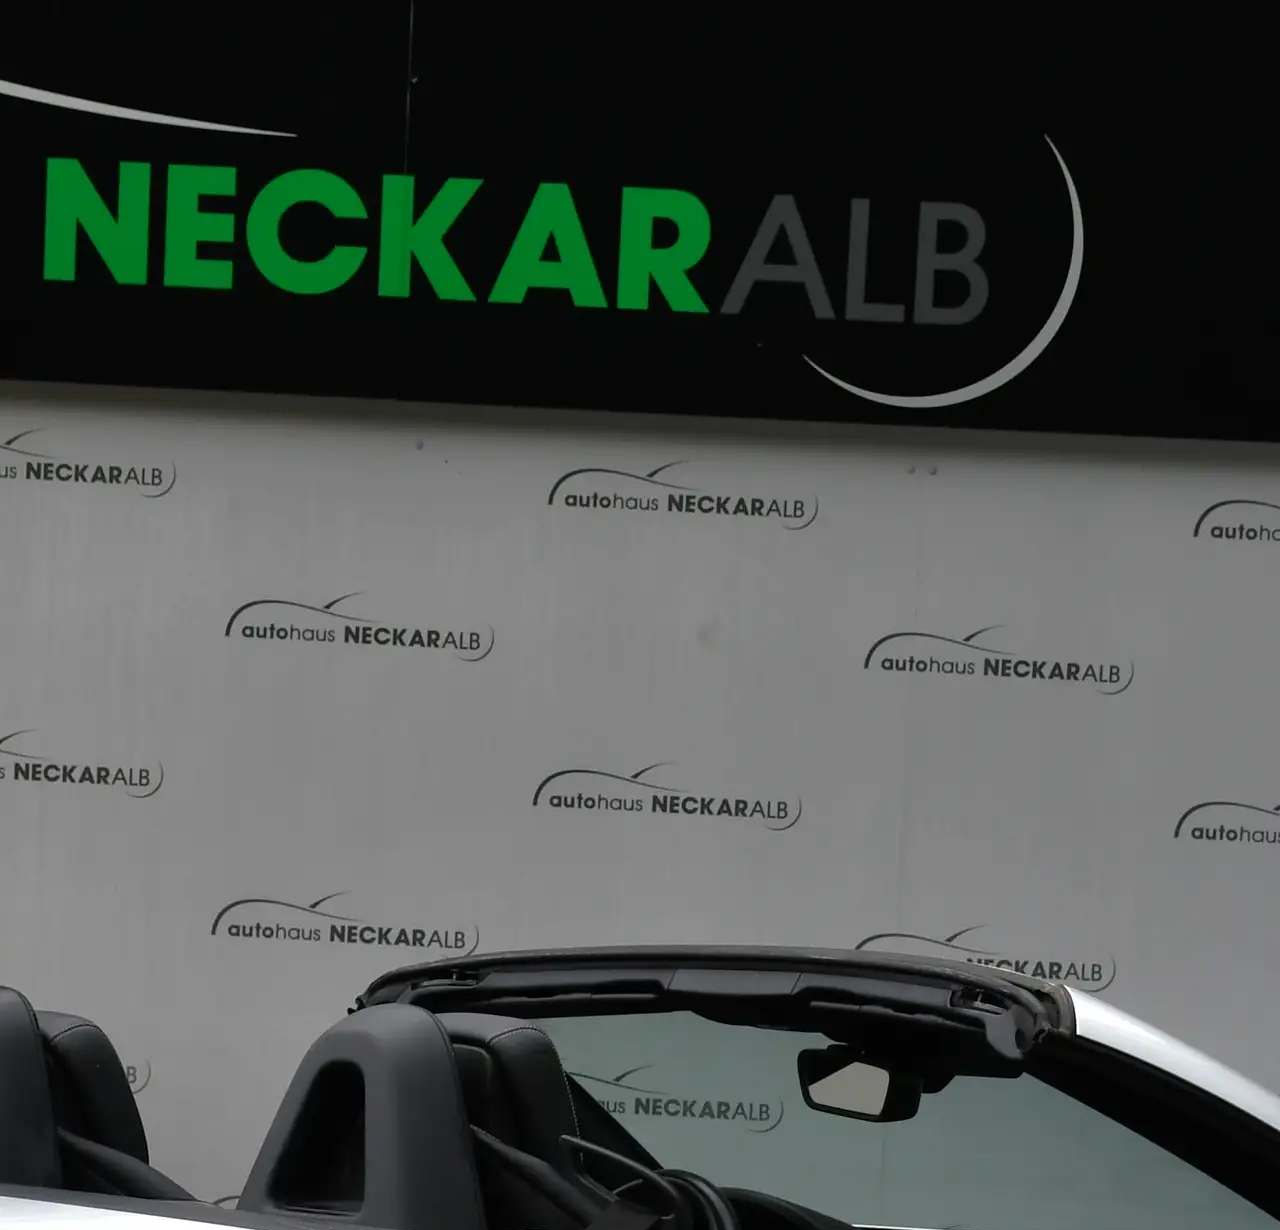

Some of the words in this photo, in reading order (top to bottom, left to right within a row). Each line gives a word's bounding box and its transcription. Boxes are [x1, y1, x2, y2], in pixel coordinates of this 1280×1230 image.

[42, 157, 990, 324] NECKARALB
[26, 462, 162, 487] NECKARALB
[565, 492, 658, 511] autohaus
[668, 494, 804, 519] NECKARALB
[241, 623, 335, 642] autohaus
[344, 625, 480, 651] NECKARALB
[881, 656, 975, 675] autohaus
[983, 658, 1120, 684] NECKARALB
[14, 762, 149, 787] NECKARALB
[549, 793, 643, 812] autohaus
[652, 795, 788, 820] NECKARALB
[228, 922, 321, 941] autohaus
[330, 924, 466, 949] NECKARALB
[634, 1097, 770, 1121] NECKARALB
